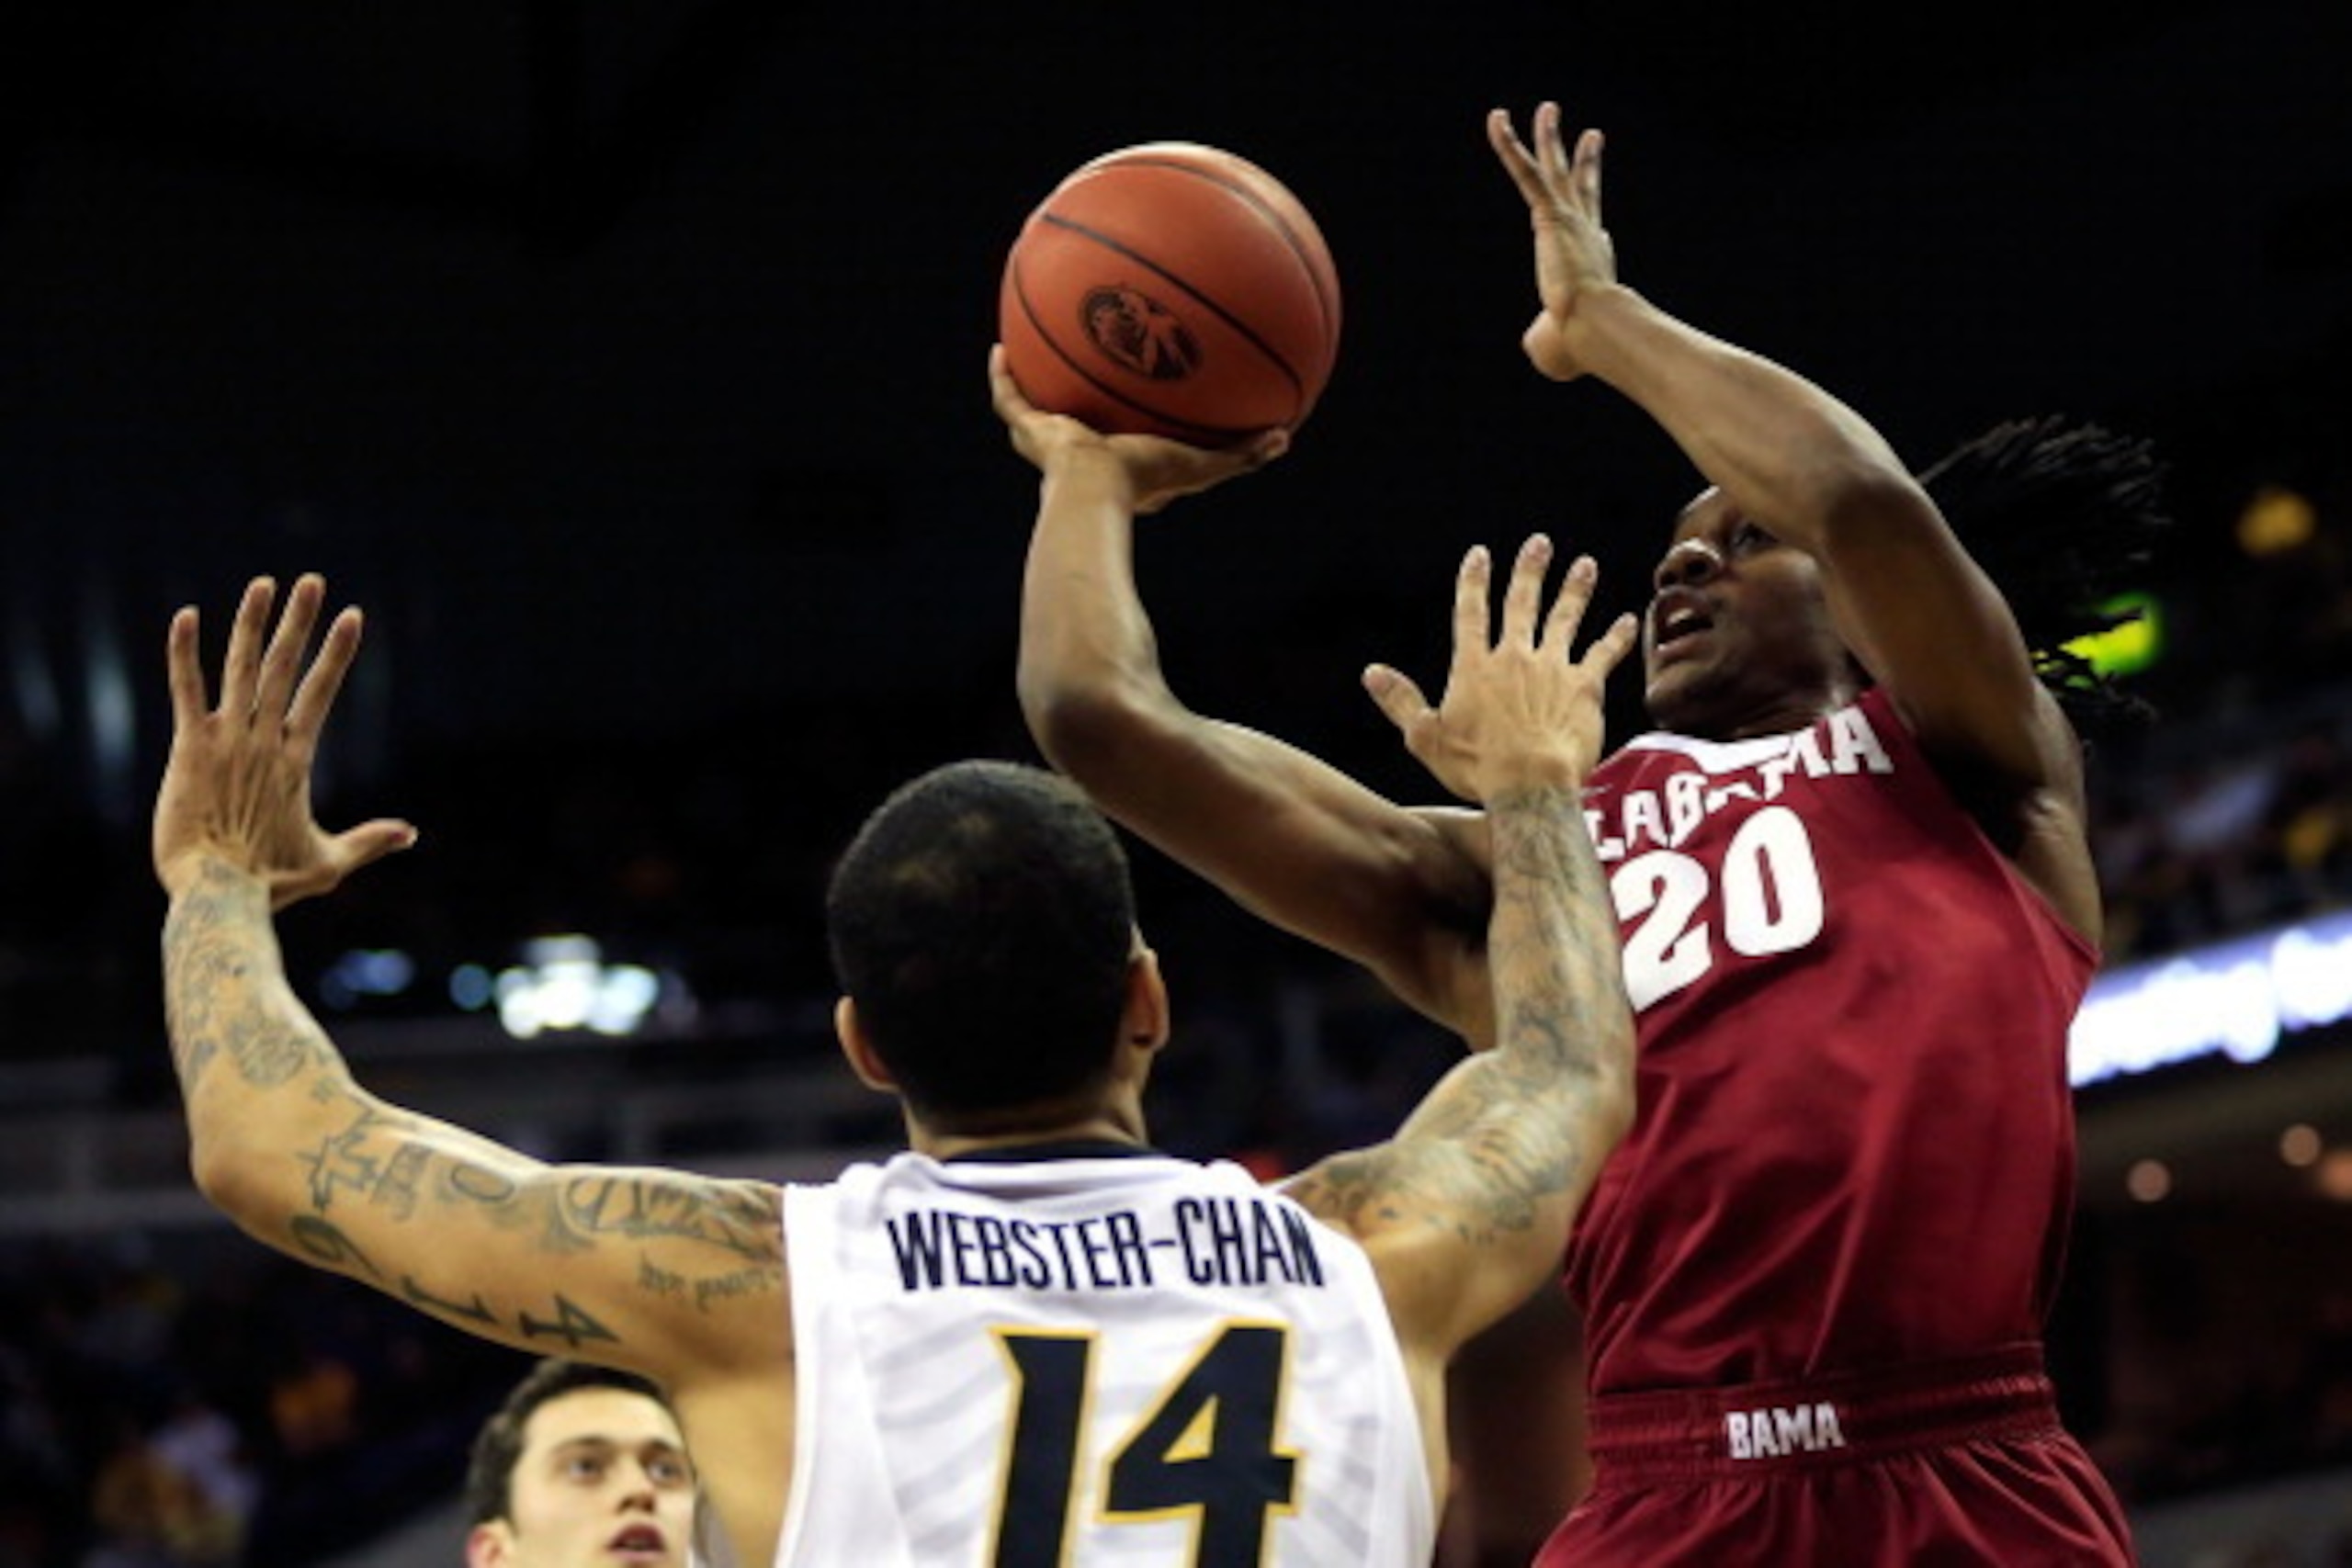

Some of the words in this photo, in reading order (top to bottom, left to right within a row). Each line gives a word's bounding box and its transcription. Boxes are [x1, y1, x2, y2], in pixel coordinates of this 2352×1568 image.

[1610, 806, 1825, 1012] 20
[887, 1197, 1324, 1291] WEBSTER-CHAN
[986, 1315, 1306, 1568] 14
[1725, 1401, 1847, 1460] BAMA
